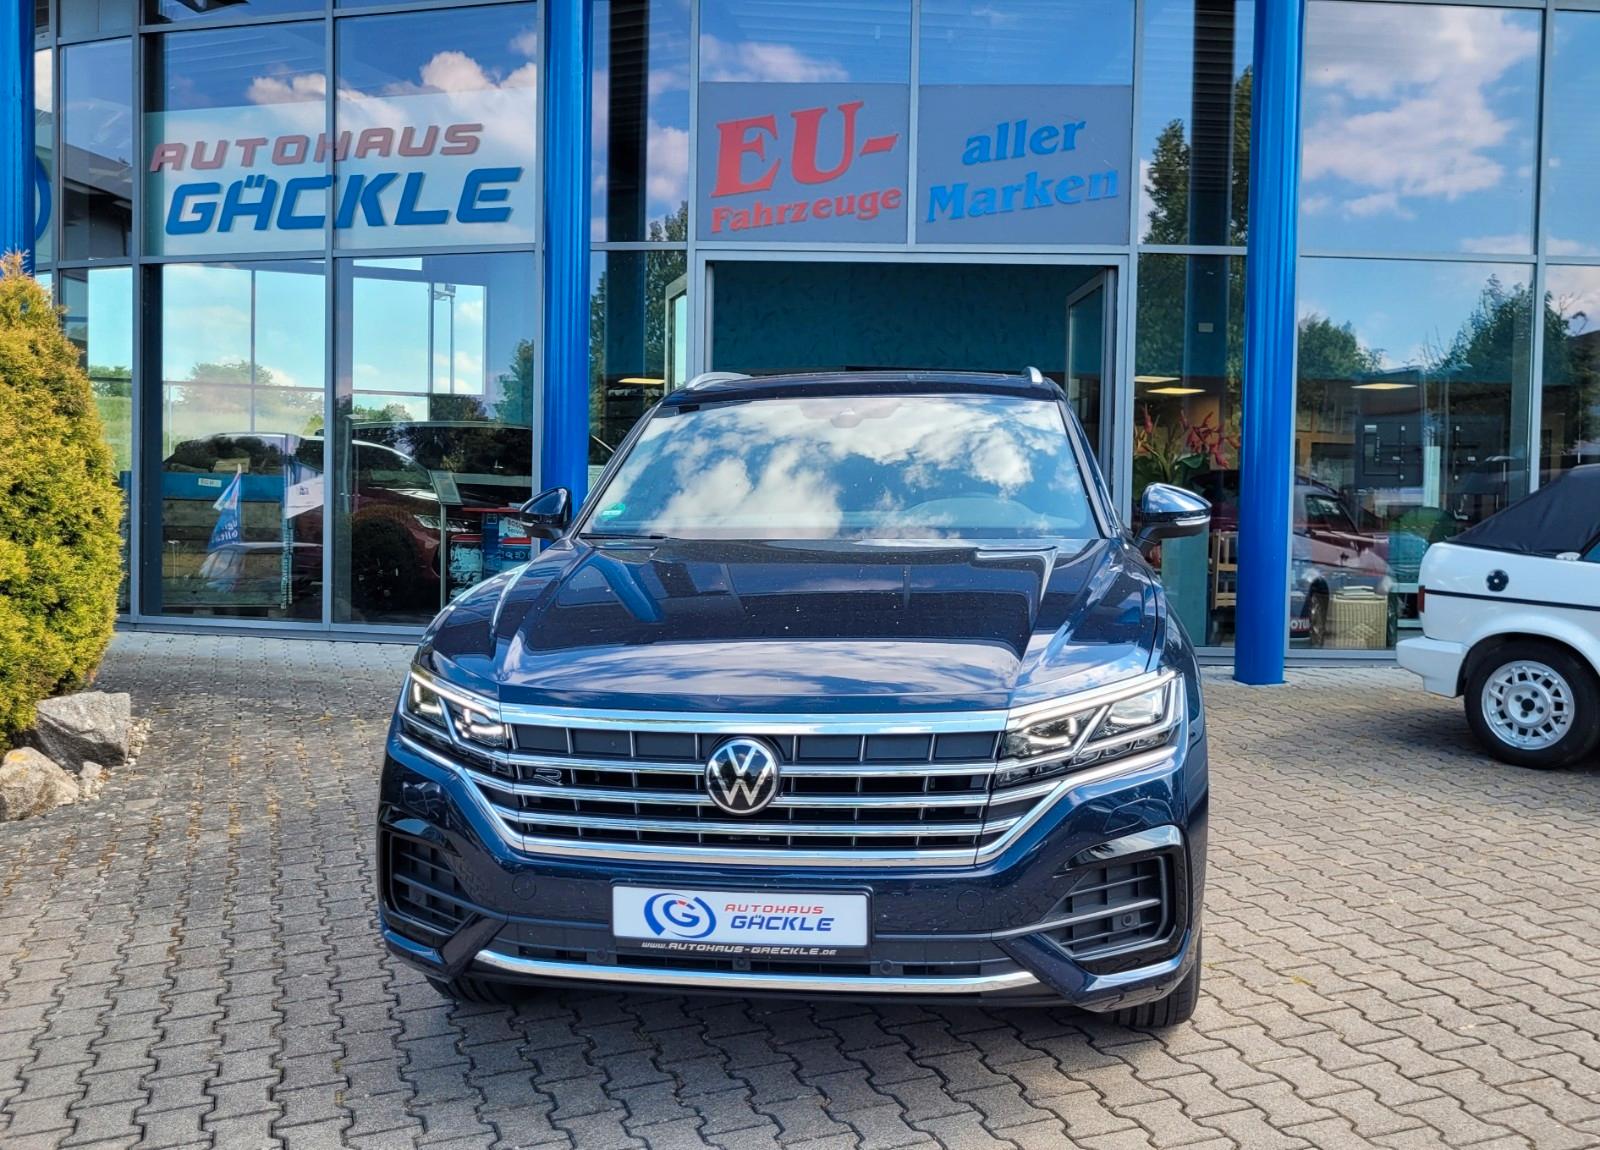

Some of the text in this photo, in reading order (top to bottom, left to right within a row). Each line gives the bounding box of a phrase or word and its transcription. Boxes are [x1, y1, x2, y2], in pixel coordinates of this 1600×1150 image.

[150, 123, 483, 172] AUTOHAUS
[711, 101, 898, 198] EU-
[961, 119, 1086, 166] aller
[165, 166, 523, 235] GÄCKLE
[711, 187, 902, 234] Fahrzeuge
[926, 168, 1120, 224] Marken
[724, 903, 825, 915] AUTOHAUS
[730, 914, 835, 932] GÄCKLE
